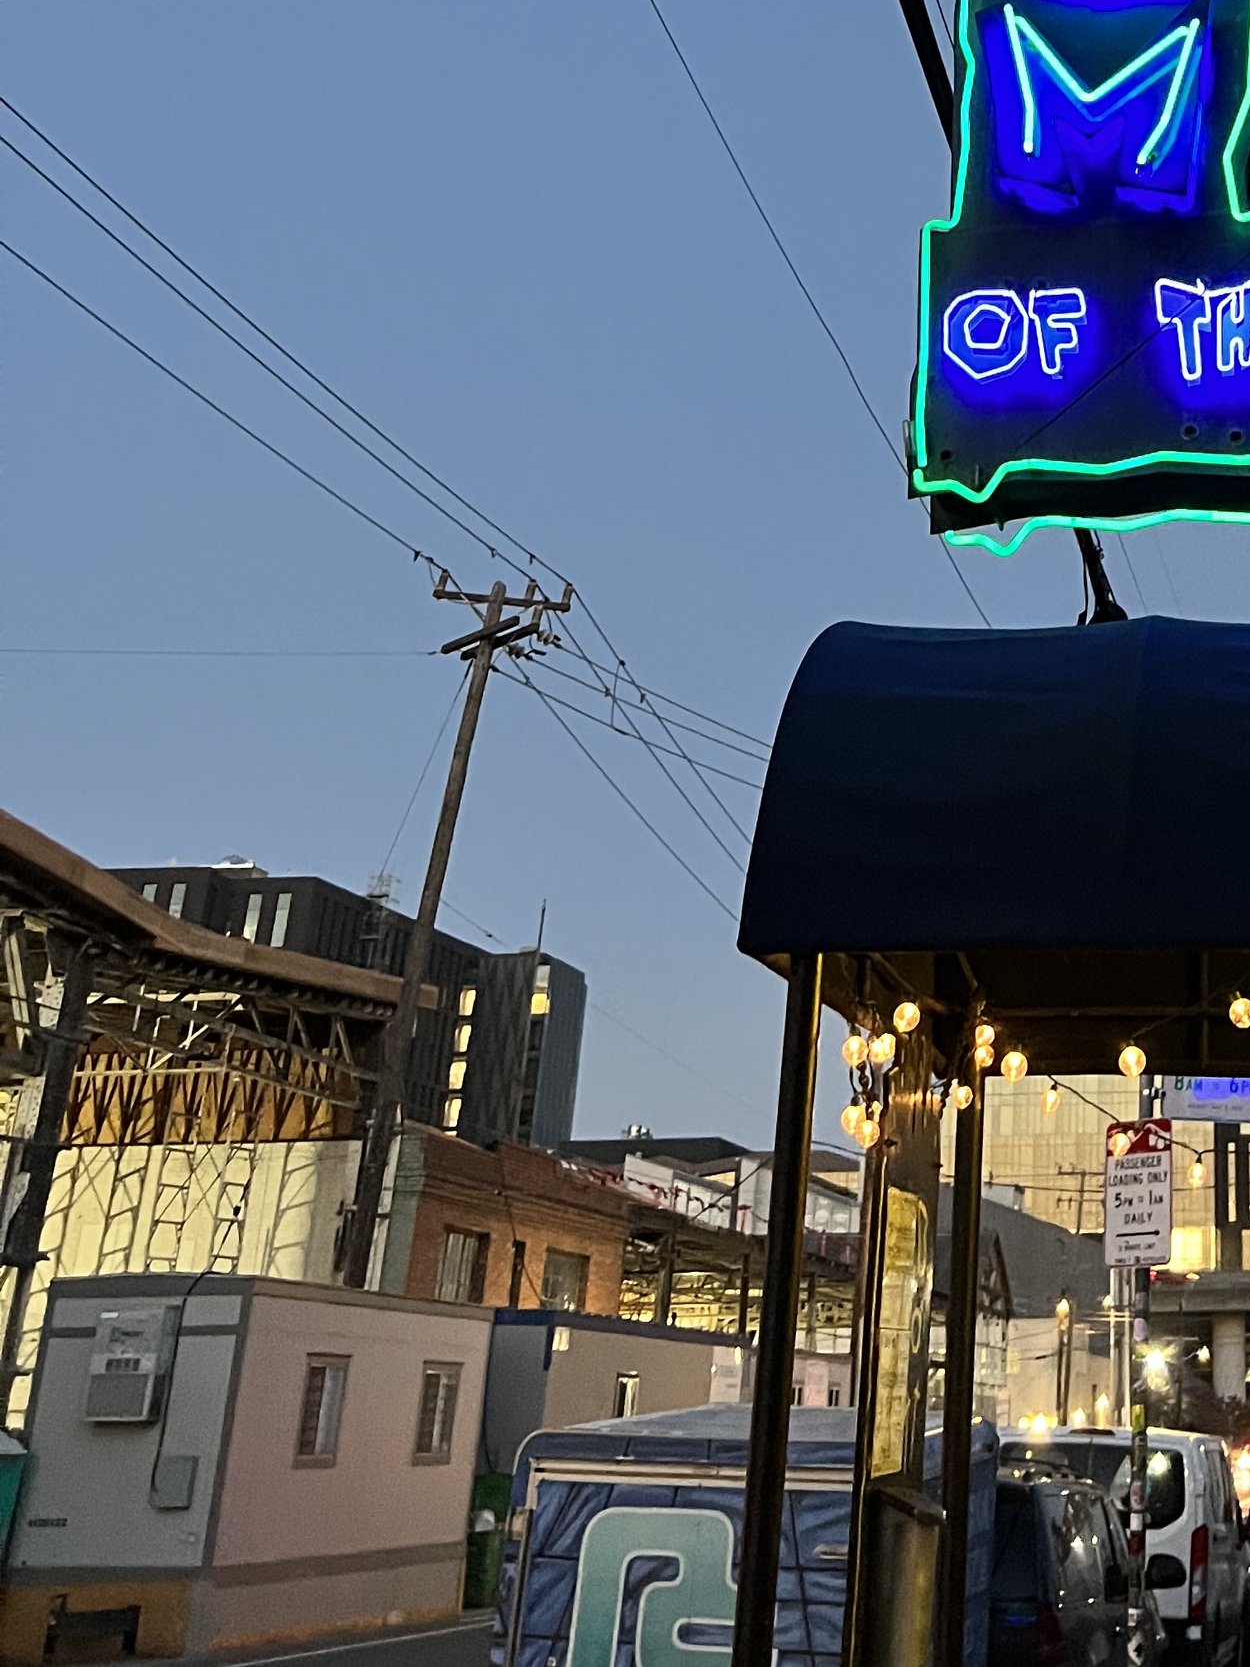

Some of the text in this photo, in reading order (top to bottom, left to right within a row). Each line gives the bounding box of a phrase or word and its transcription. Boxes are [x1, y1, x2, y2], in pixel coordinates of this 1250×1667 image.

[943, 287, 1086, 381] OF
[1108, 1172, 1144, 1187] LOADING
[1124, 1210, 1153, 1226] DAILY
